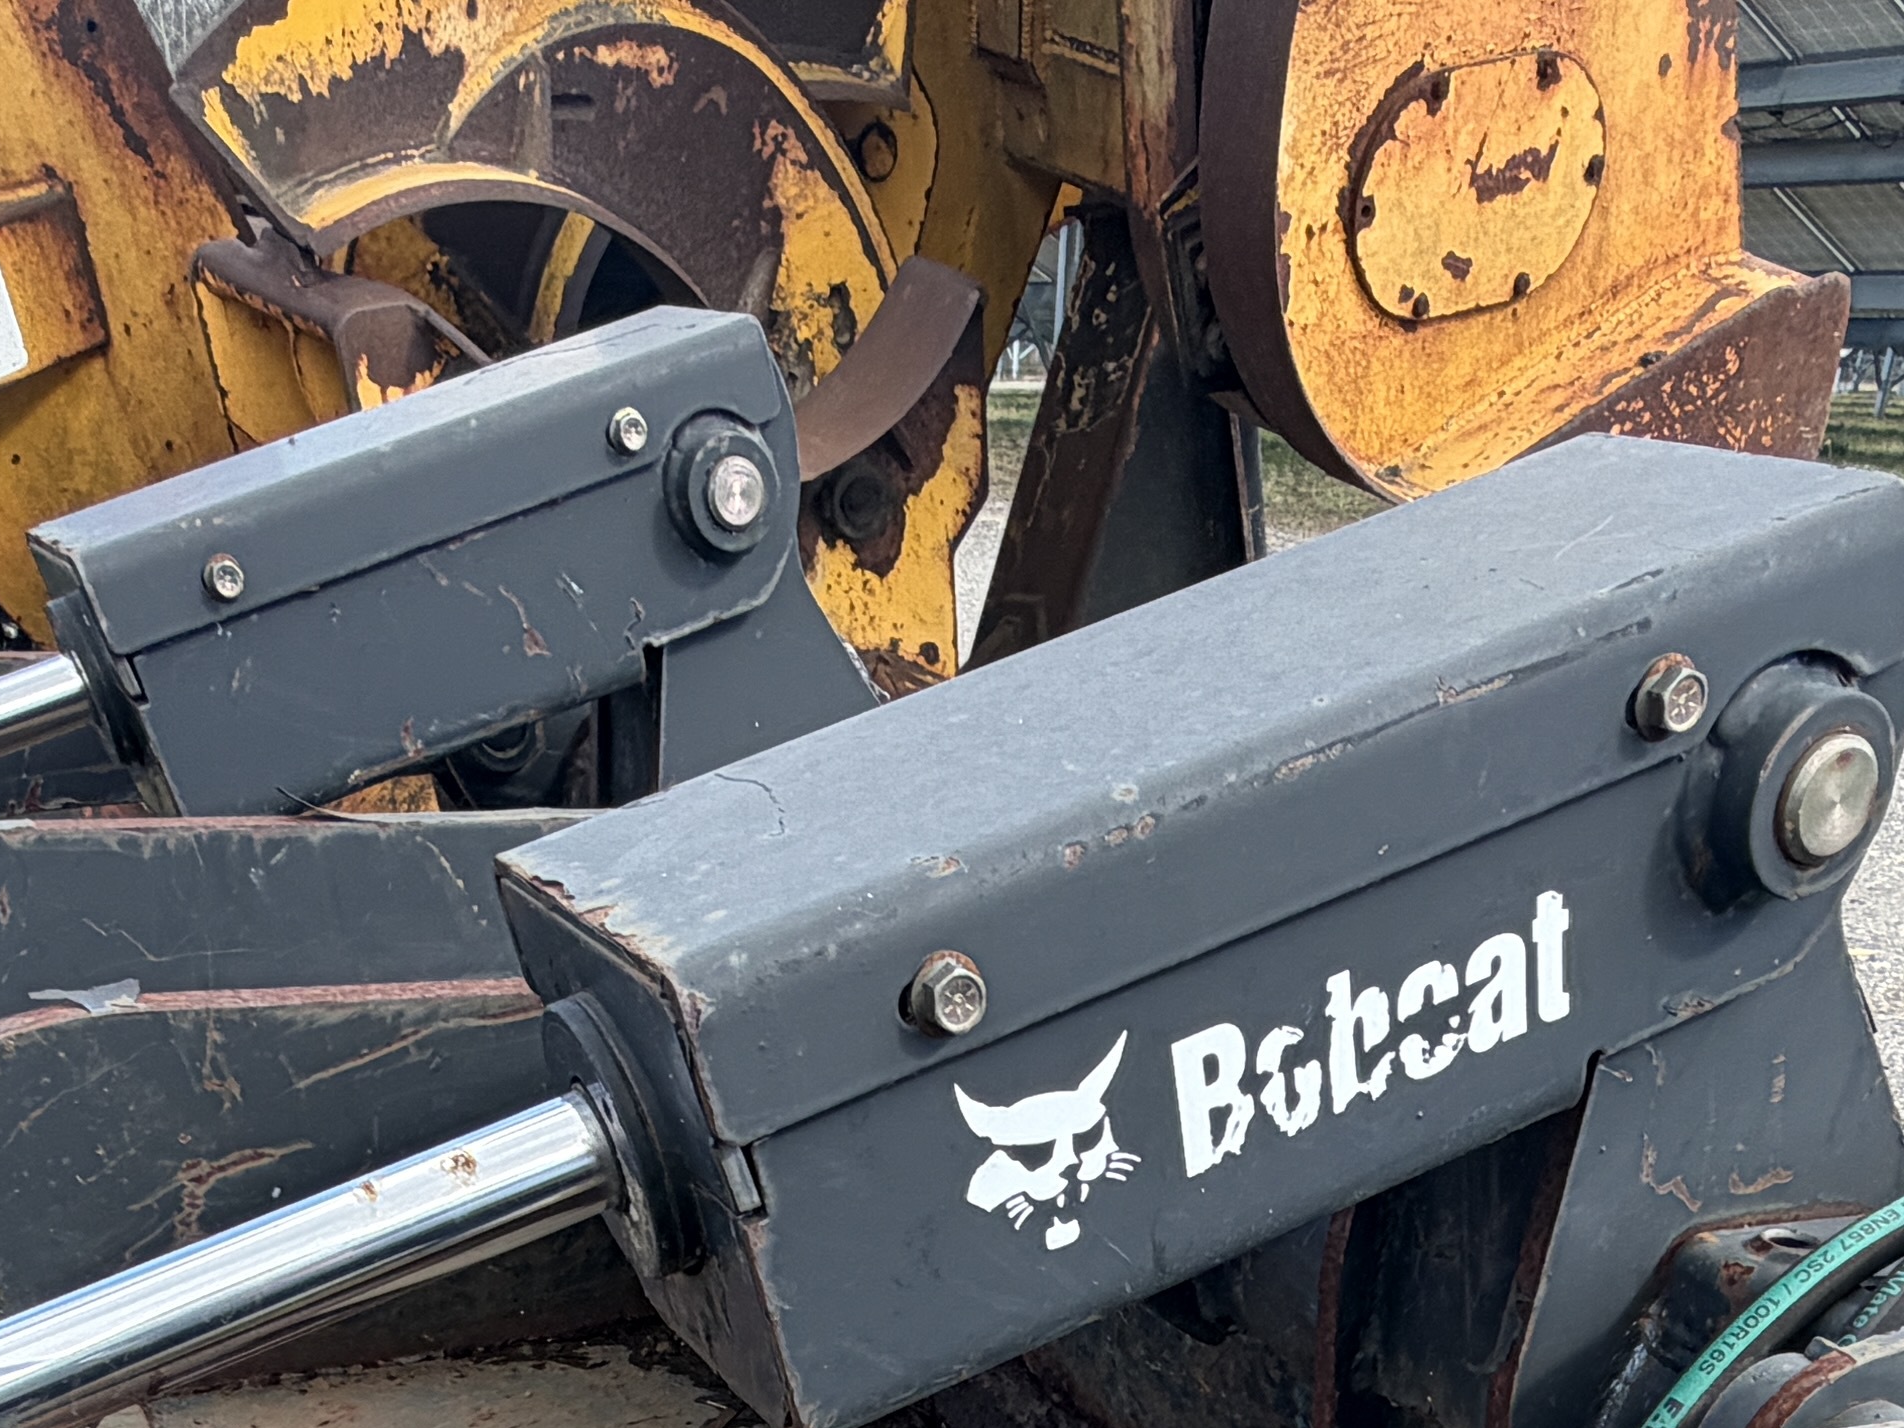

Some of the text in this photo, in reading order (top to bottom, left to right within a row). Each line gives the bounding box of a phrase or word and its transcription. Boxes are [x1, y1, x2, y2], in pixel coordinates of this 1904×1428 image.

[1170, 888, 1572, 1178] Bobcat
[1795, 1249, 1836, 1284] 2SC
[1698, 1297, 1781, 1376] 100R16S
